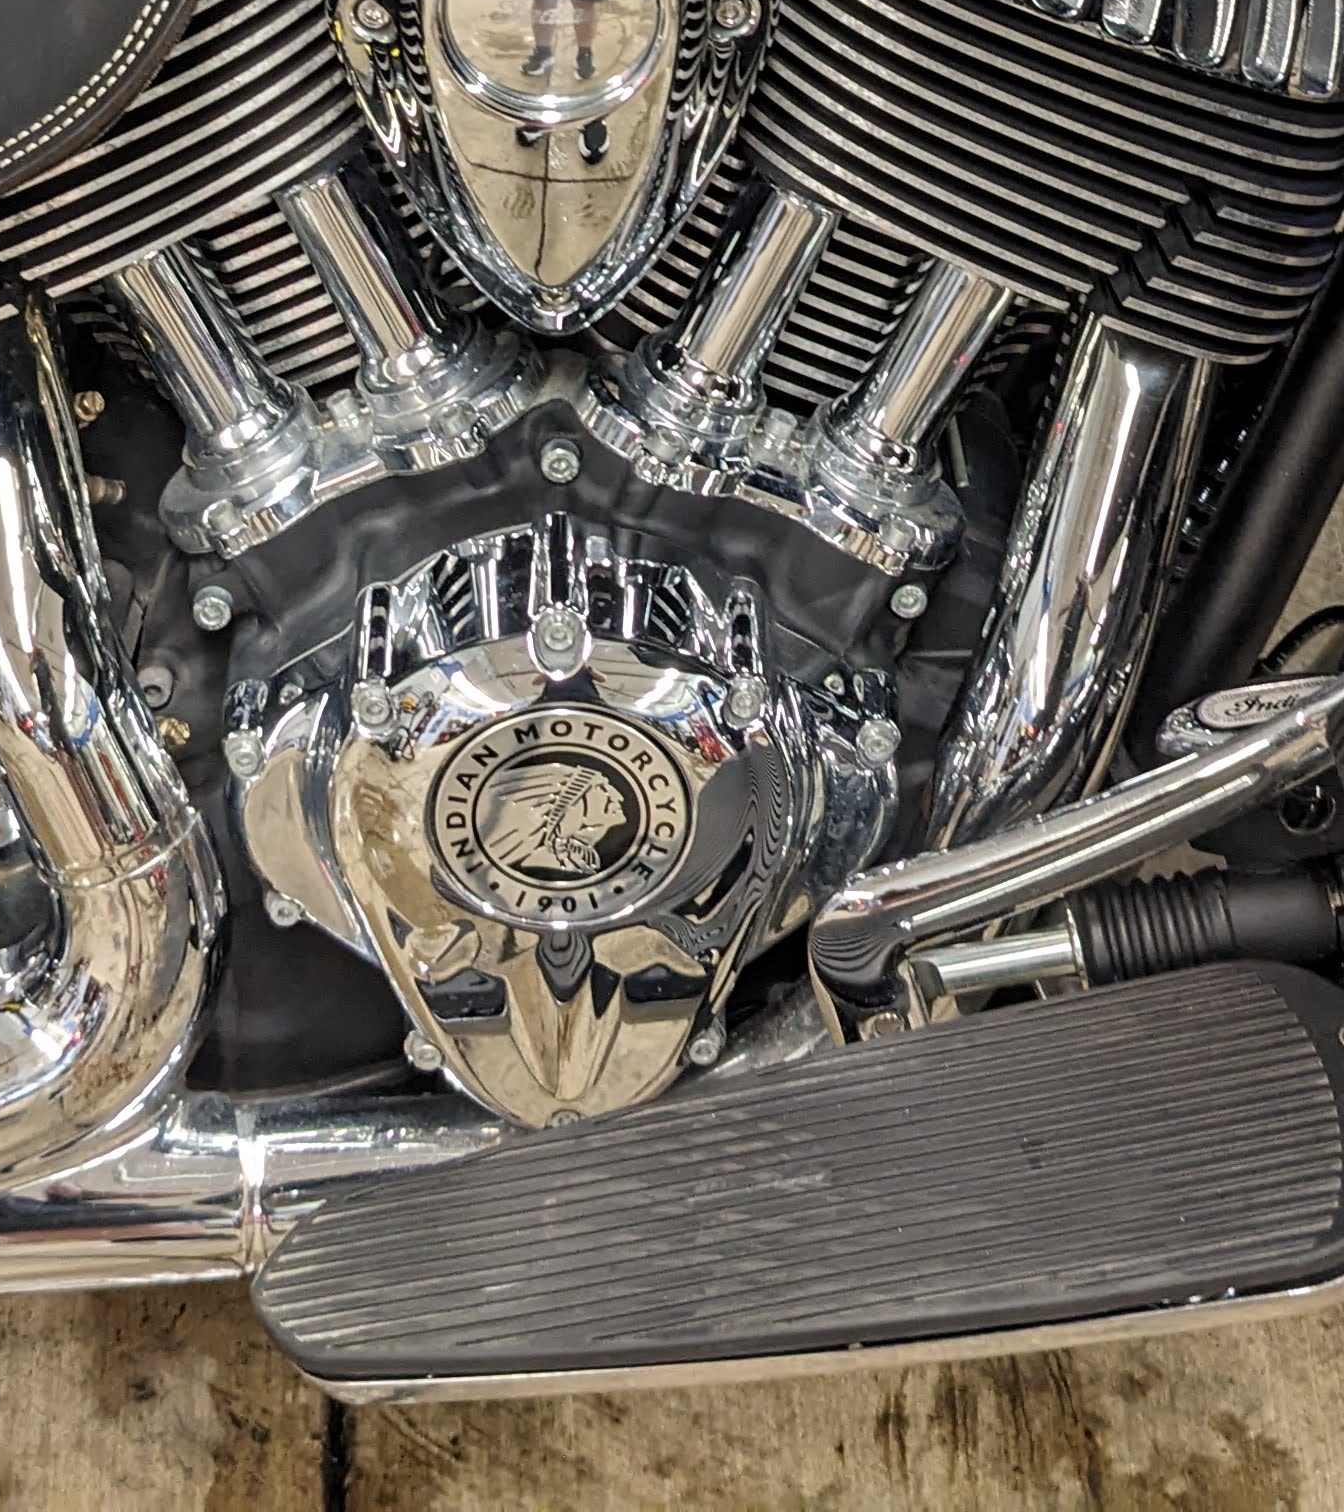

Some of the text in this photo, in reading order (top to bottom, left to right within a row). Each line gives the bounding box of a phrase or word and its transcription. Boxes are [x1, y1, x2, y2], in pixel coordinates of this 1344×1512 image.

[445, 719, 677, 881] INDIAN MOTORCYCLE
[515, 890, 600, 914] 1901
